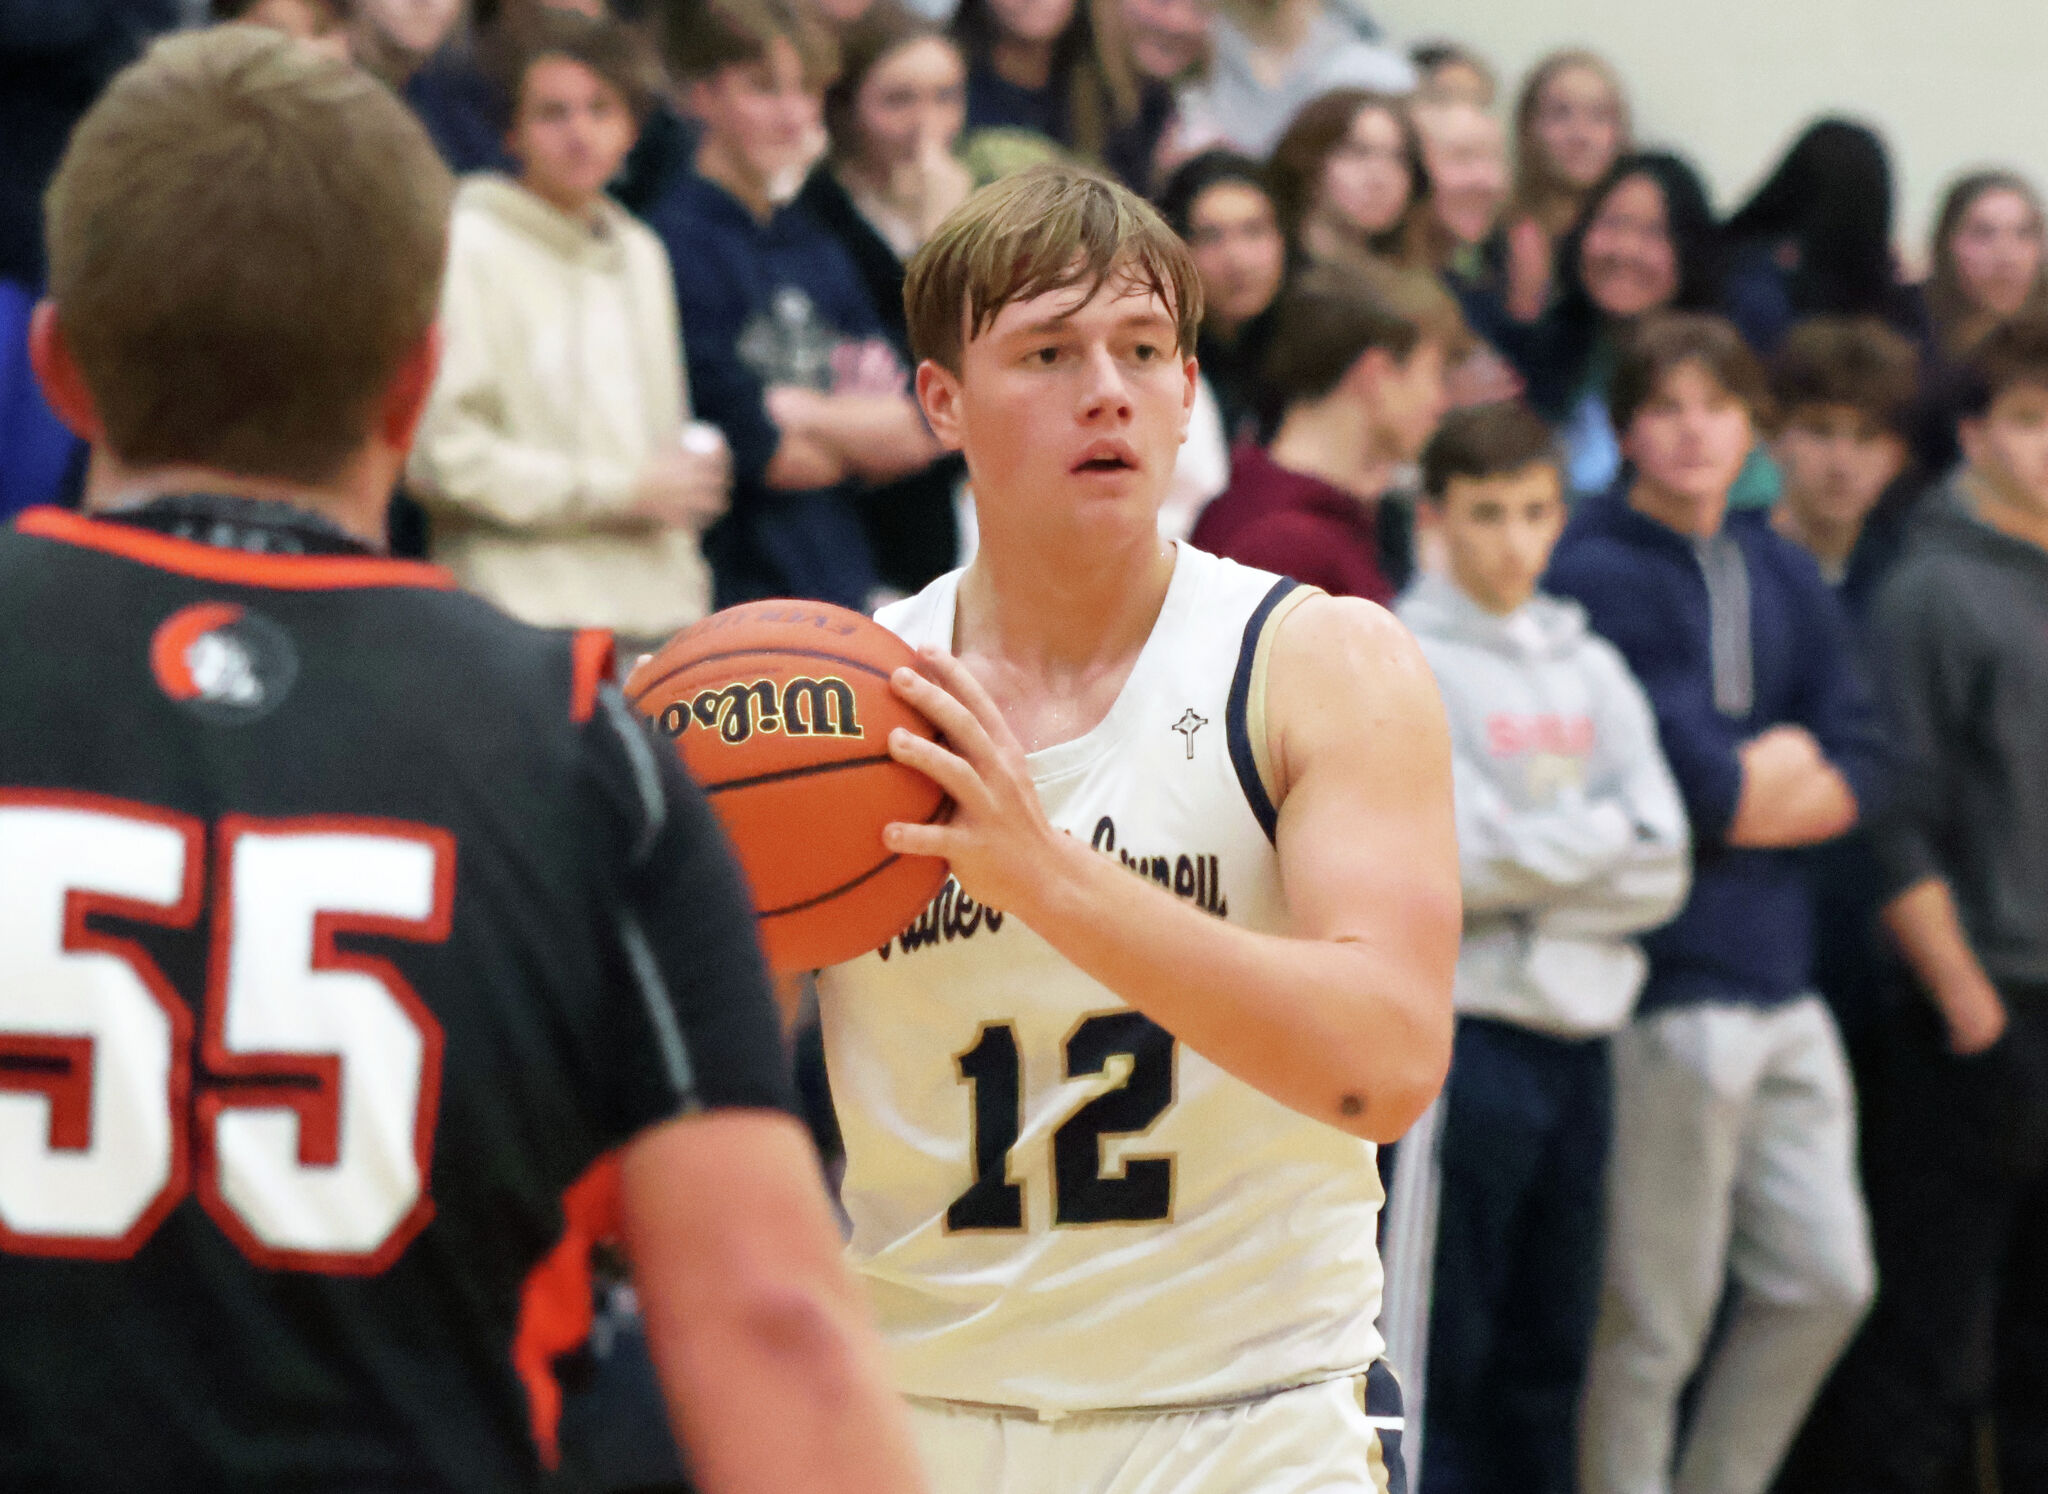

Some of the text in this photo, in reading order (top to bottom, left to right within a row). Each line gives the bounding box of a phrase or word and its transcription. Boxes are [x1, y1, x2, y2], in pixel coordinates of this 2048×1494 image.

[650, 676, 864, 744] Wilso
[0, 786, 456, 1276] 55
[941, 1006, 1178, 1237] 12
